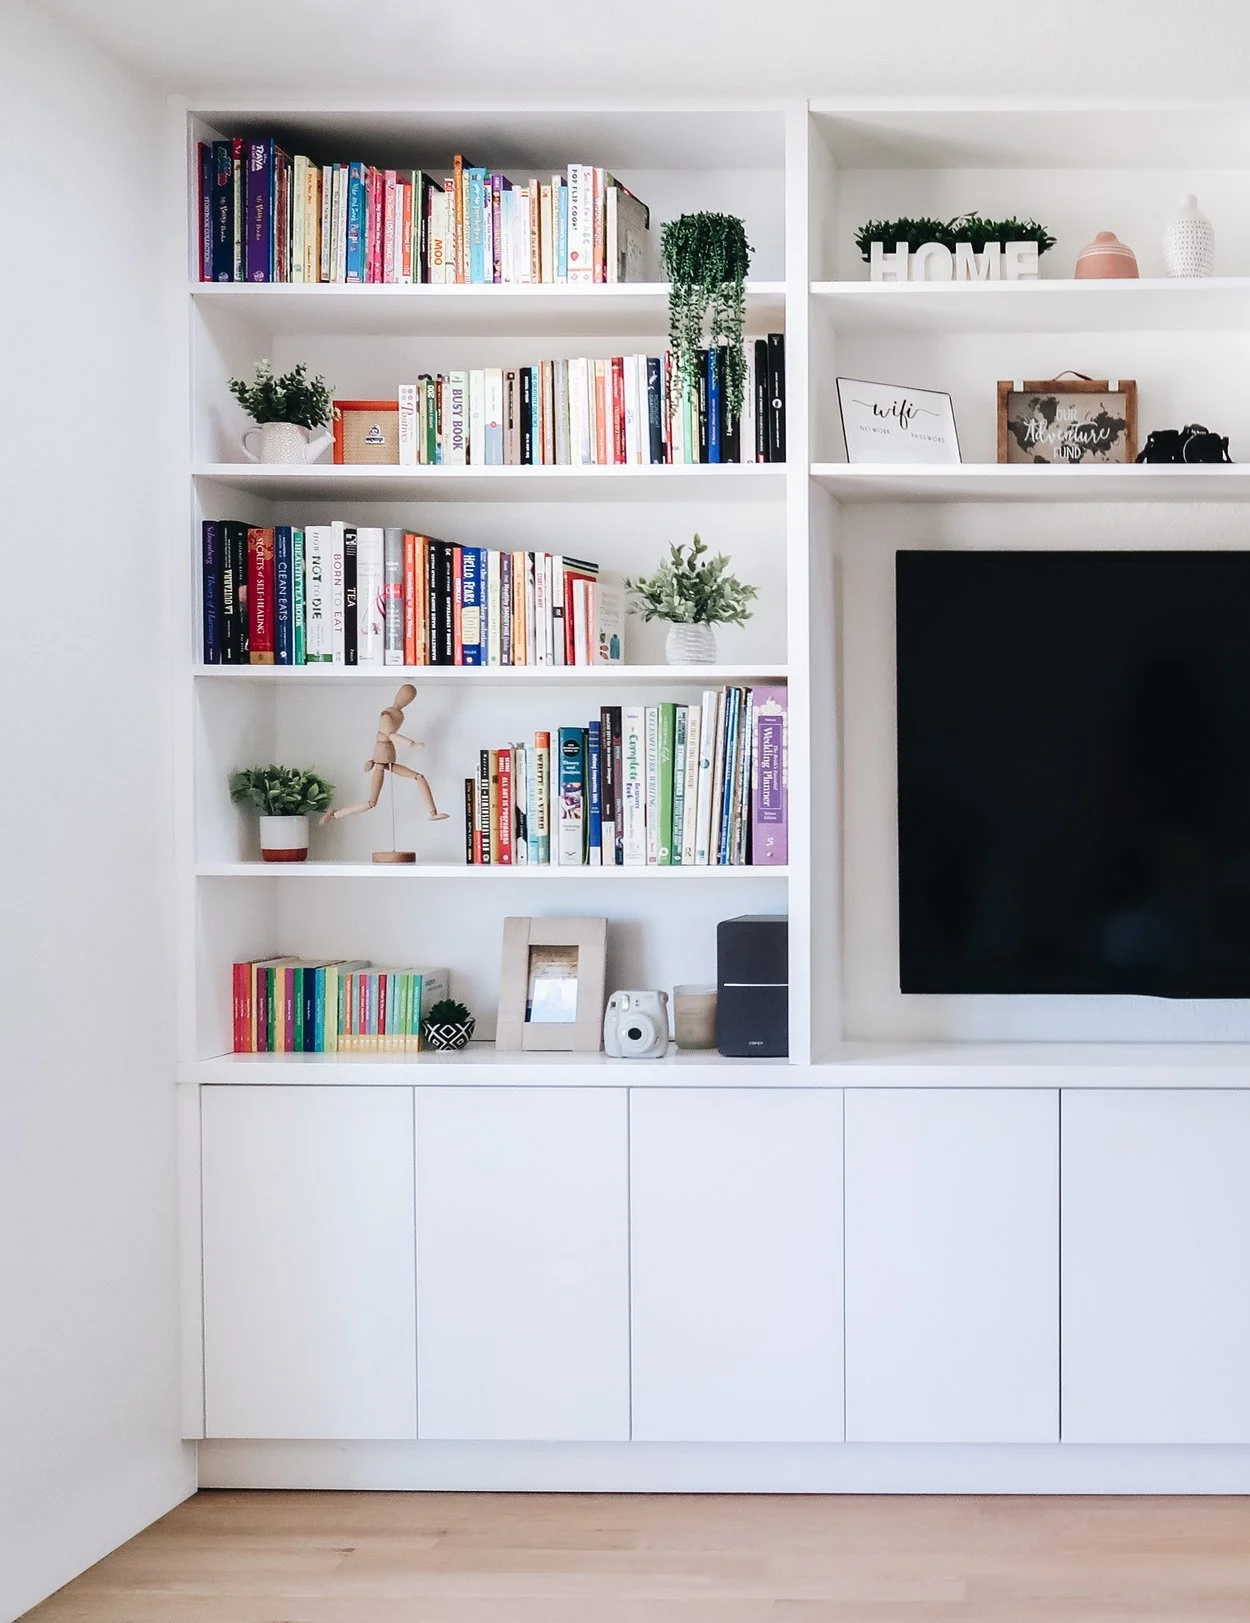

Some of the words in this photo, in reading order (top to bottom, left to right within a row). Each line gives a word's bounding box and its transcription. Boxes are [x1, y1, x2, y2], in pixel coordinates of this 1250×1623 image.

[255, 145, 264, 171] RAYA
[434, 239, 443, 266] MOO
[870, 241, 1039, 281] HOME
[427, 384, 435, 399] 200
[452, 388, 463, 417] BUSY
[401, 402, 414, 444] Positives
[852, 399, 940, 431] wifi
[1056, 408, 1078, 421] OUR
[452, 420, 463, 451] BOOK
[859, 425, 892, 435] NETWORK
[911, 433, 945, 443] PASSWORD
[1023, 418, 1111, 444] Adventure
[1053, 446, 1082, 459] FUND
[205, 525, 215, 565] Schoenberg
[256, 537, 265, 571] SECRETS
[295, 543, 304, 583] HEALTHY
[312, 555, 322, 583] NOT
[333, 553, 342, 586] BORN
[207, 574, 215, 599] Theory
[278, 561, 287, 595] CLEAN
[206, 600, 216, 608] of
[295, 584, 304, 601] TEA
[333, 591, 342, 607] TO
[347, 587, 356, 607] TEA
[463, 581, 475, 603] FEARS
[502, 583, 510, 605] Healthy
[224, 606, 233, 615] LA
[256, 579, 265, 635] SELF-HEALING
[278, 598, 287, 621] EATS
[295, 604, 304, 627] BOOK
[312, 598, 322, 620] DIE
[479, 604, 487, 621] sleep
[206, 610, 216, 646] Harmony
[334, 611, 342, 633] EAT
[625, 734, 640, 781] Complete
[761, 727, 773, 769] Wedding
[648, 776, 657, 808] WRITING
[762, 770, 773, 807] Planner
[502, 807, 510, 845] PROPAGANDA
